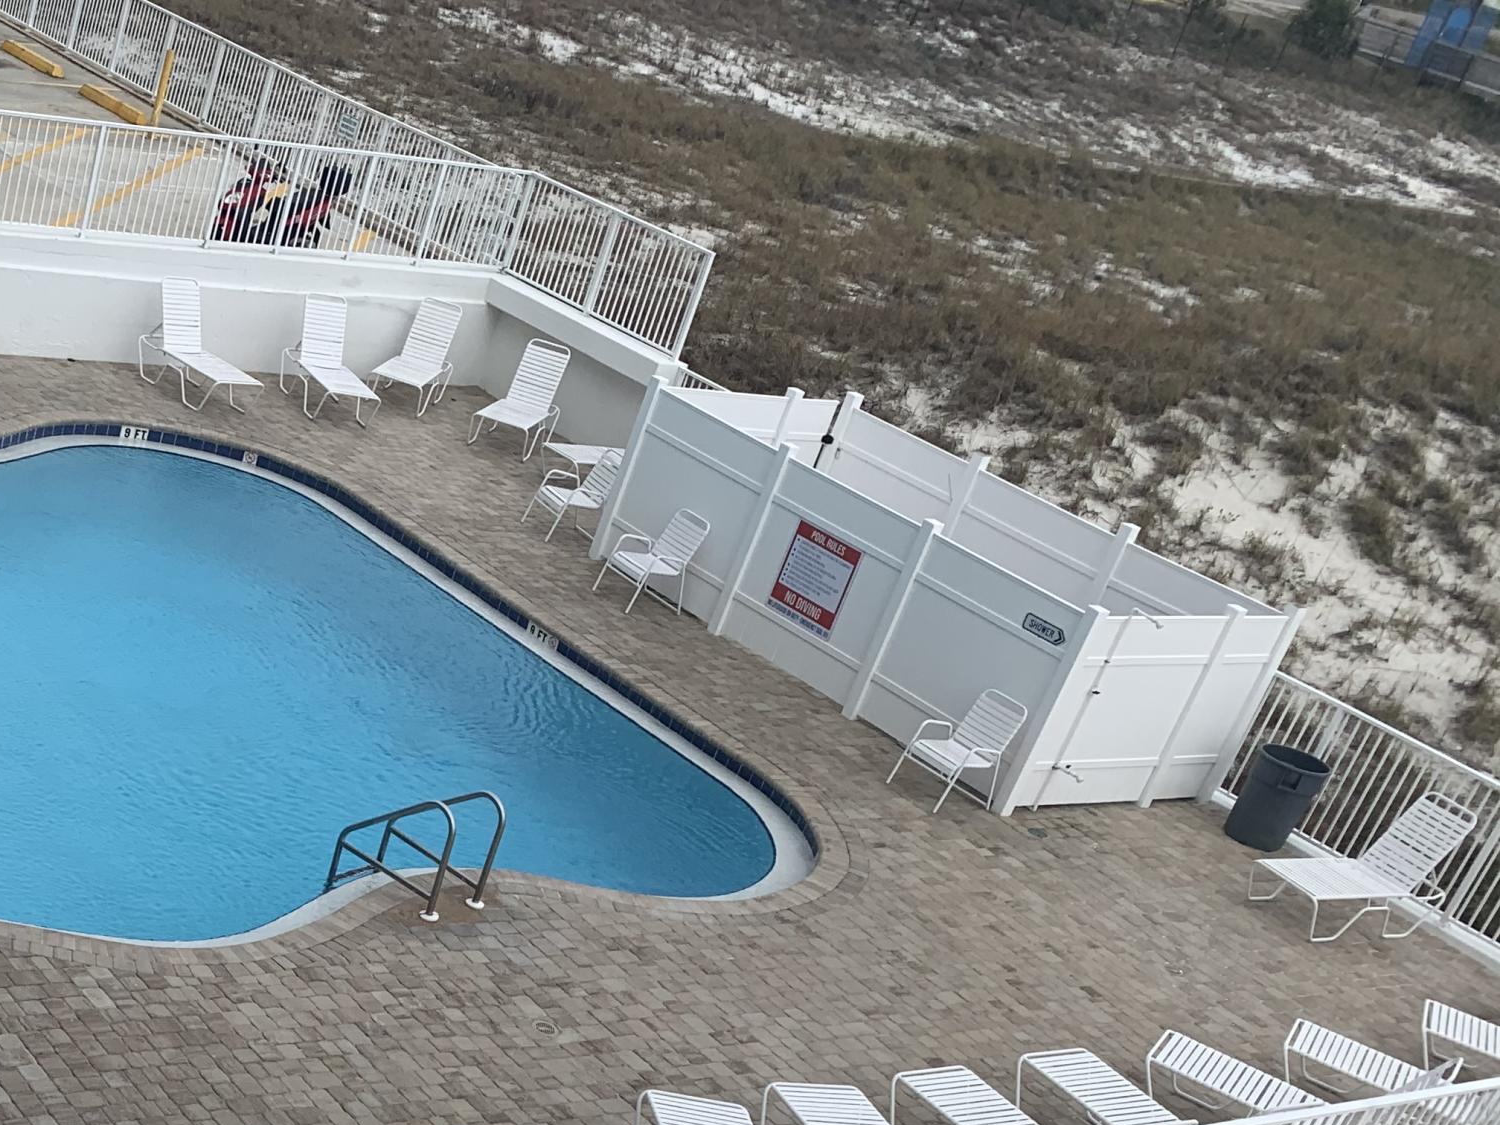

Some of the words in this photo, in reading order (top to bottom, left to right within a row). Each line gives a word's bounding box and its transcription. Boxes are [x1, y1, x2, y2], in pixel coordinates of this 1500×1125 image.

[124, 427, 131, 438] 9
[134, 428, 148, 441] FT
[811, 530, 827, 546] POOL
[827, 538, 846, 556] RULES
[784, 590, 797, 605] NO
[795, 596, 822, 621] DIVING
[537, 629, 548, 643] FT
[1028, 619, 1056, 639] SHOWER
